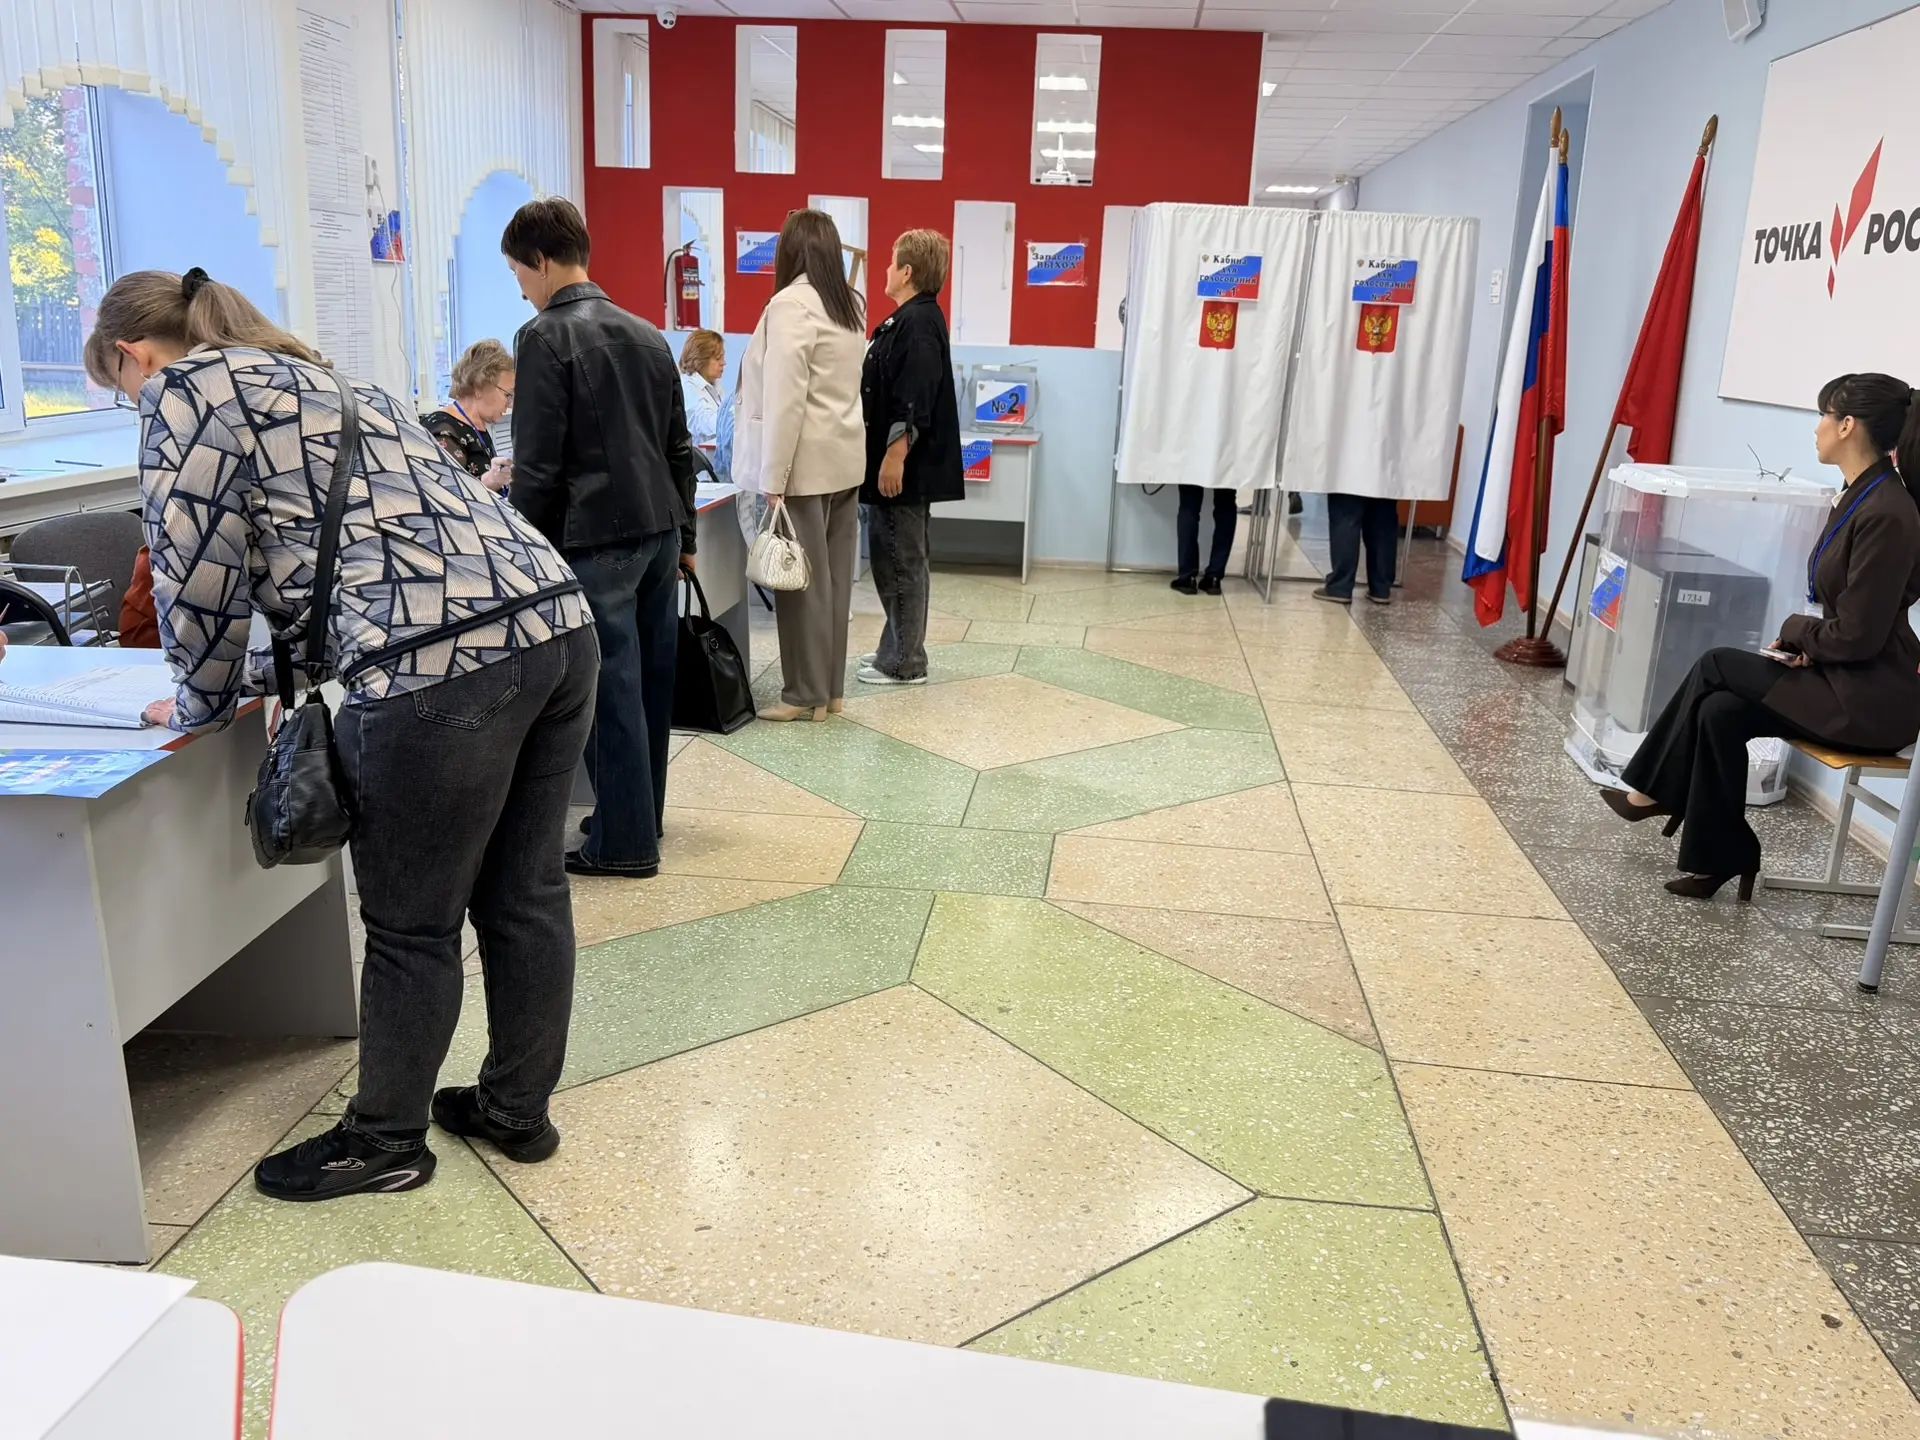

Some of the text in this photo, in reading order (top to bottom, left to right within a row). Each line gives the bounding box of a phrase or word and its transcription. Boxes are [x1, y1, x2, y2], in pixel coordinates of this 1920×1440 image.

[1754, 206, 1920, 264] ТОЧКА РОС
[1213, 254, 1248, 265] Кабина
[1368, 259, 1403, 270] Кабина
